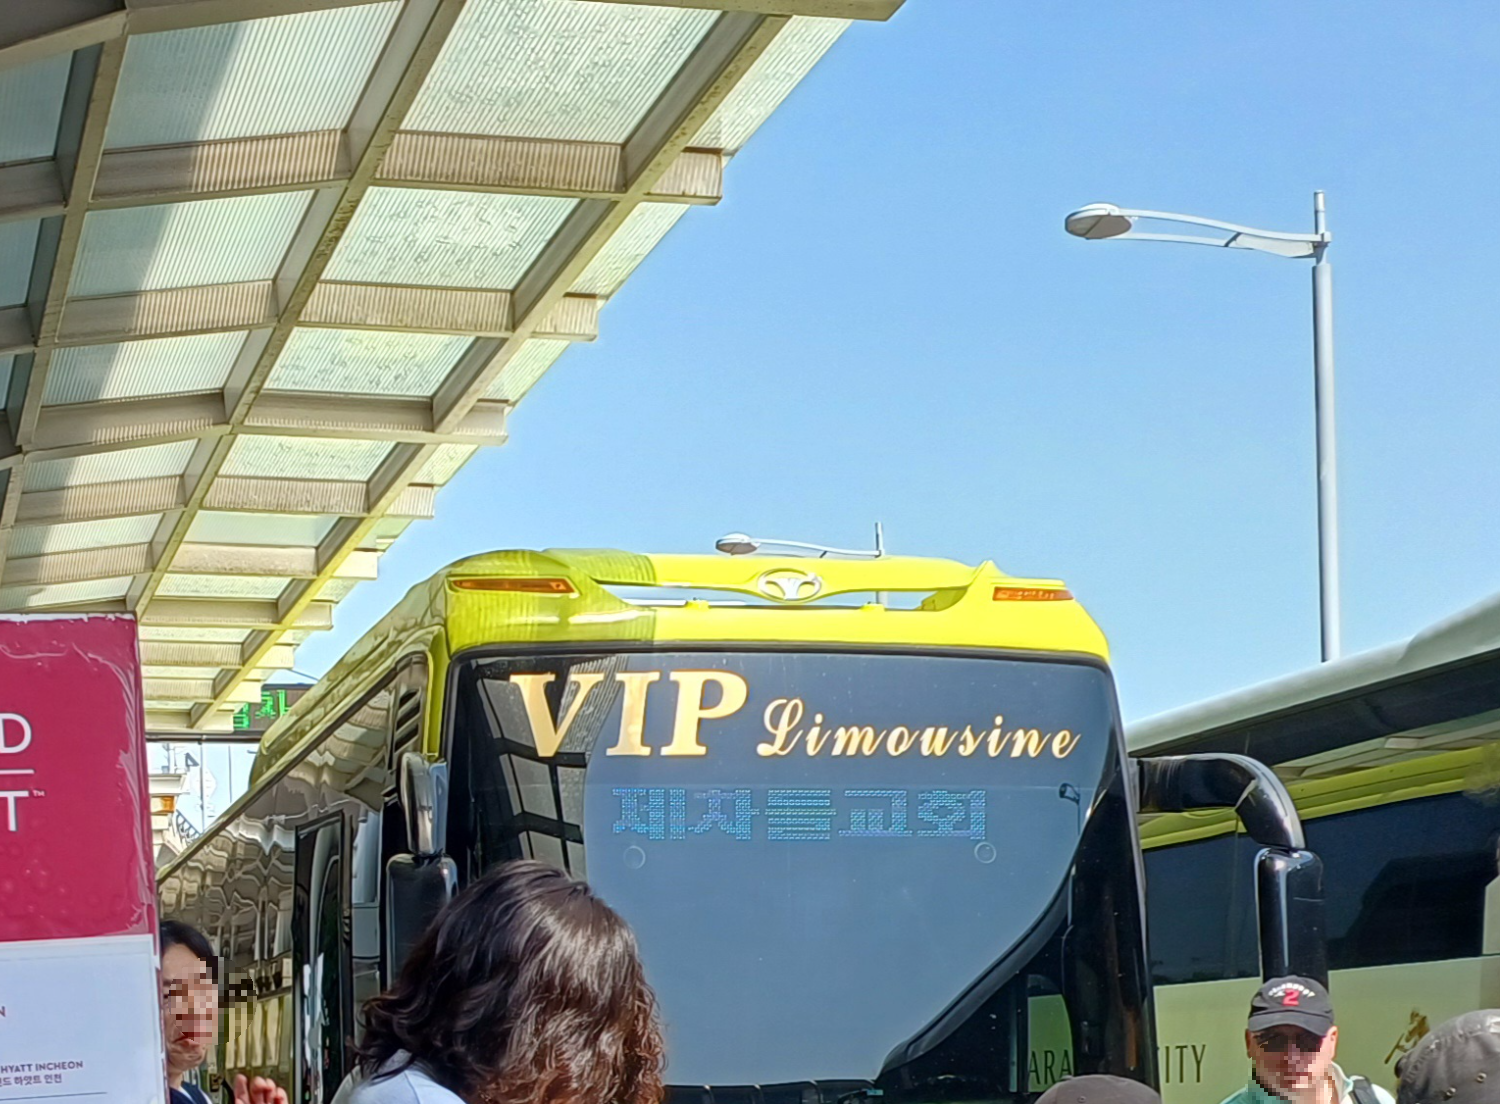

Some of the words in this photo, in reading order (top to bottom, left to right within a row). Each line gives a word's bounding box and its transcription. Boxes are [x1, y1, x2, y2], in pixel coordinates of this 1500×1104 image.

[509, 668, 749, 759] VIP
[756, 697, 1082, 760] Limousine
[612, 788, 986, 840] 제자들교회
[1282, 988, 1299, 1007] 2
[0, 1063, 33, 1074] HYATT
[35, 1060, 83, 1072] INCHEON
[1164, 1044, 1206, 1083] ITY
[14, 1075, 41, 1086] 하얏트
[44, 1073, 62, 1084] 인천
